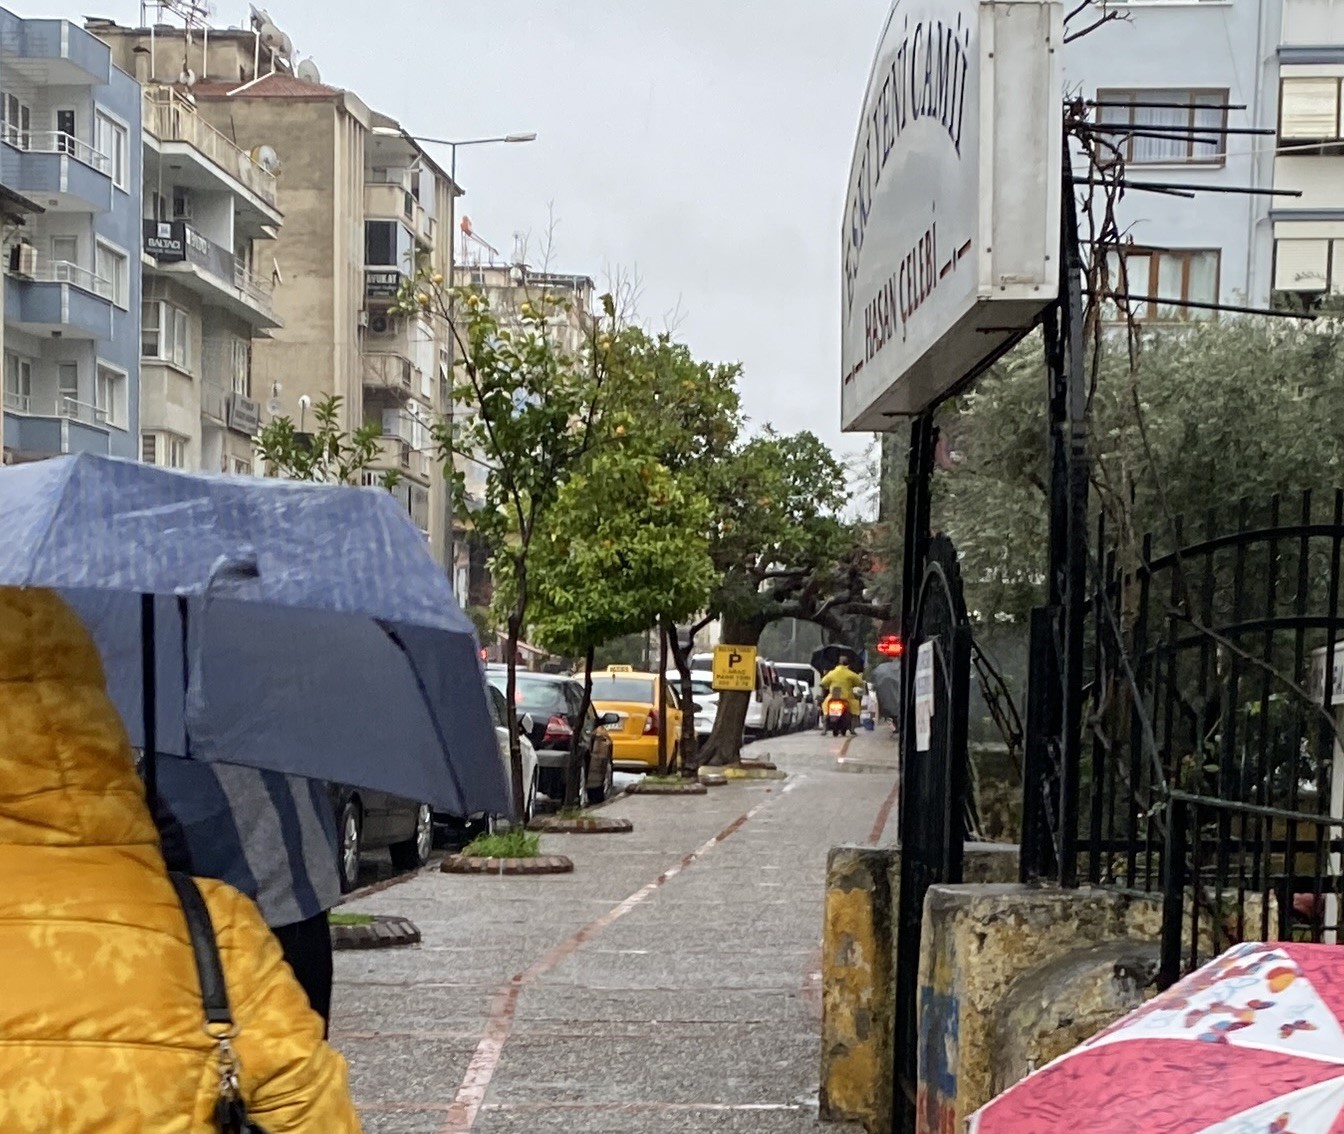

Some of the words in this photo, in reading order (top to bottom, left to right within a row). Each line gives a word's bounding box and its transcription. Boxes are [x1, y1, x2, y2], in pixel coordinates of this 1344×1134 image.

[864, 272, 898, 363] HASAN
[899, 200, 938, 343] ÇELEBİ
[728, 653, 743, 669] P
